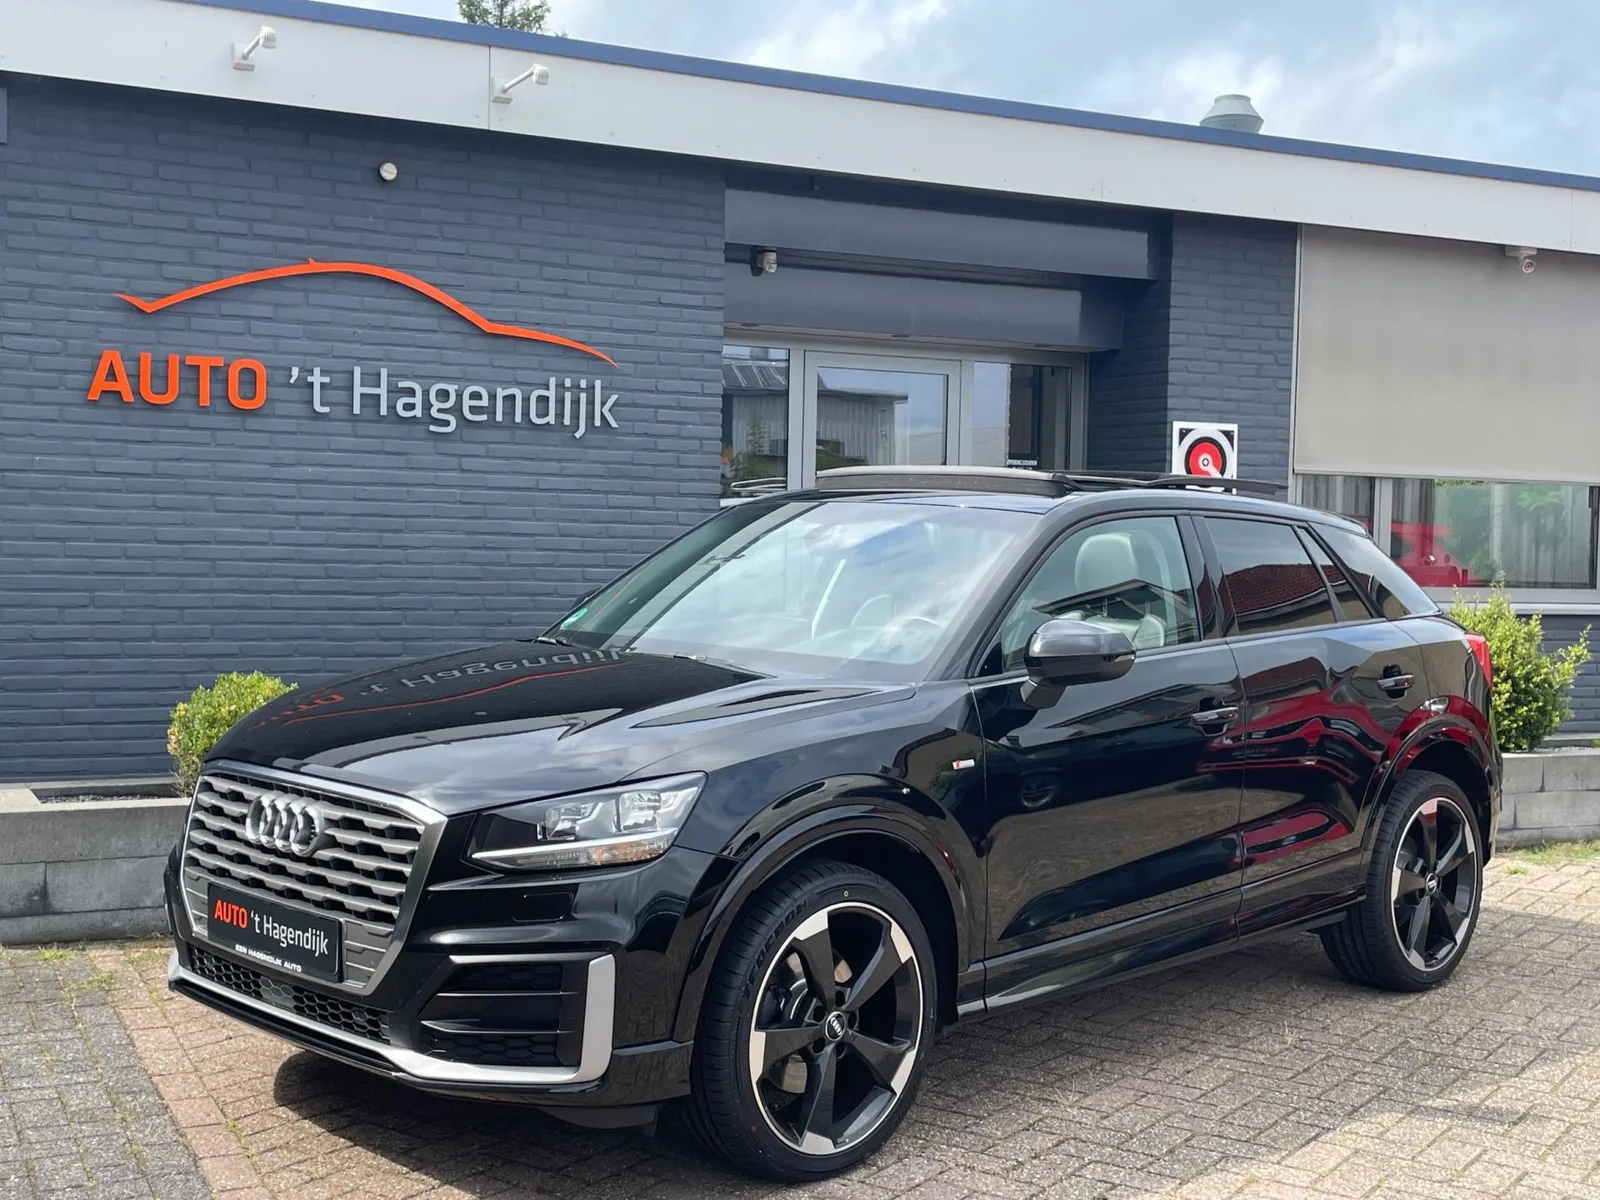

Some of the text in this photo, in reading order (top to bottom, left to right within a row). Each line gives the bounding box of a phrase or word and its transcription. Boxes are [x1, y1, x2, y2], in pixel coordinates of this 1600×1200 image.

[87, 350, 267, 410] AUTO
[353, 366, 621, 439] Hagendijk
[215, 900, 247, 928] AUTO
[263, 915, 328, 956] Hagendijk
[283, 960, 302, 973] AUTO
